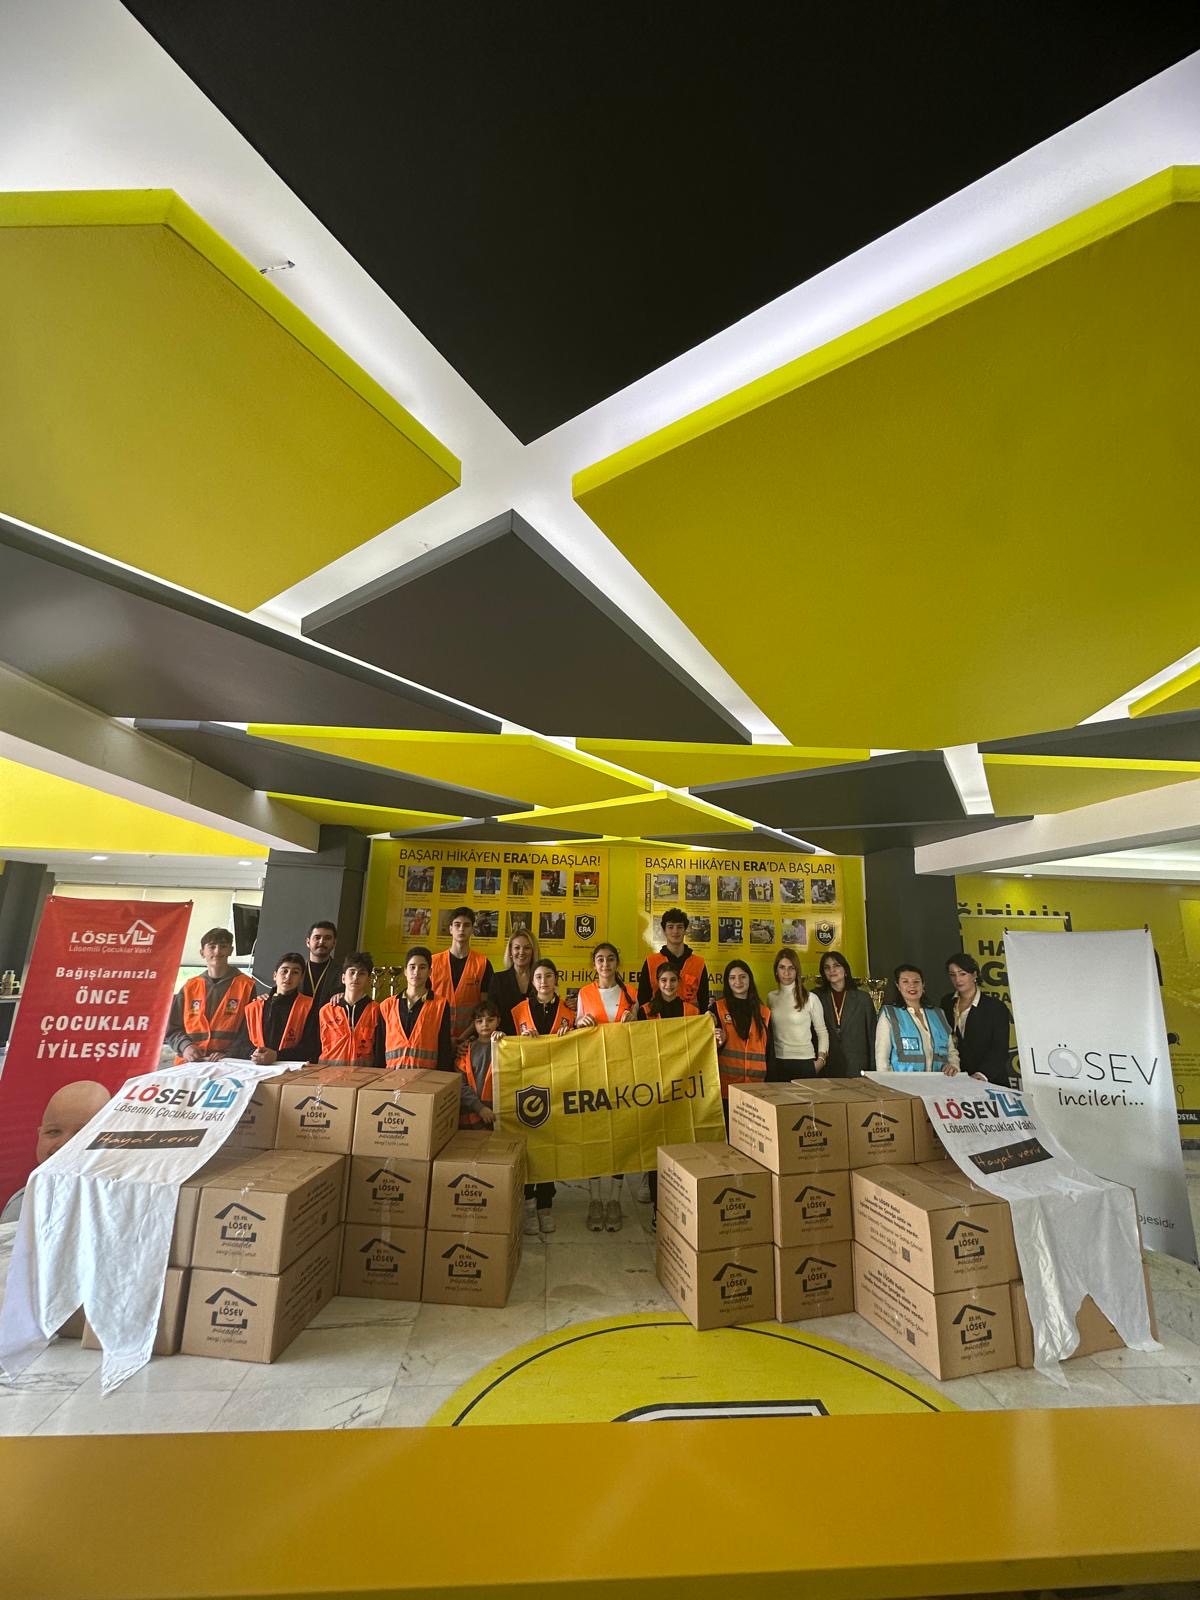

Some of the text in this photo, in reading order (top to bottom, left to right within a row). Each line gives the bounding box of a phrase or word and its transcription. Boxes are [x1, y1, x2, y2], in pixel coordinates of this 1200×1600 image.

[400, 849, 443, 863] BAŞARI
[447, 849, 501, 863] HİKÂYEN
[552, 854, 601, 868] BAŞLAR!
[645, 857, 686, 871] BAŞARI
[689, 857, 740, 871] HİKÂYEN
[789, 862, 836, 876] BAŞLAR!
[70, 931, 132, 945] LÖSEV
[55, 966, 157, 981] Bağışlarınızla
[75, 985, 130, 1005] ÖNCE
[40, 1015, 149, 1036] ÇOCUKLAR
[36, 1039, 141, 1062] İYİLEŞSİN
[1030, 1043, 1158, 1086] LÖSEV
[123, 1084, 207, 1107] LÖSEV
[562, 1070, 705, 1115] ERA KOLEJİ
[113, 1103, 226, 1122] Lösemili Çocuklar Vakfı
[934, 1098, 1000, 1120] LÖSEV
[383, 1115, 405, 1125] LÖSEV
[943, 1123, 980, 1134] Lösemili
[979, 1120, 1016, 1136] Çocuklar
[97, 1132, 200, 1149] Hayat verir
[975, 1148, 1013, 1170] Hayat
[228, 1220, 253, 1230] LÖSEV
[219, 1306, 243, 1316] LÖSEV
